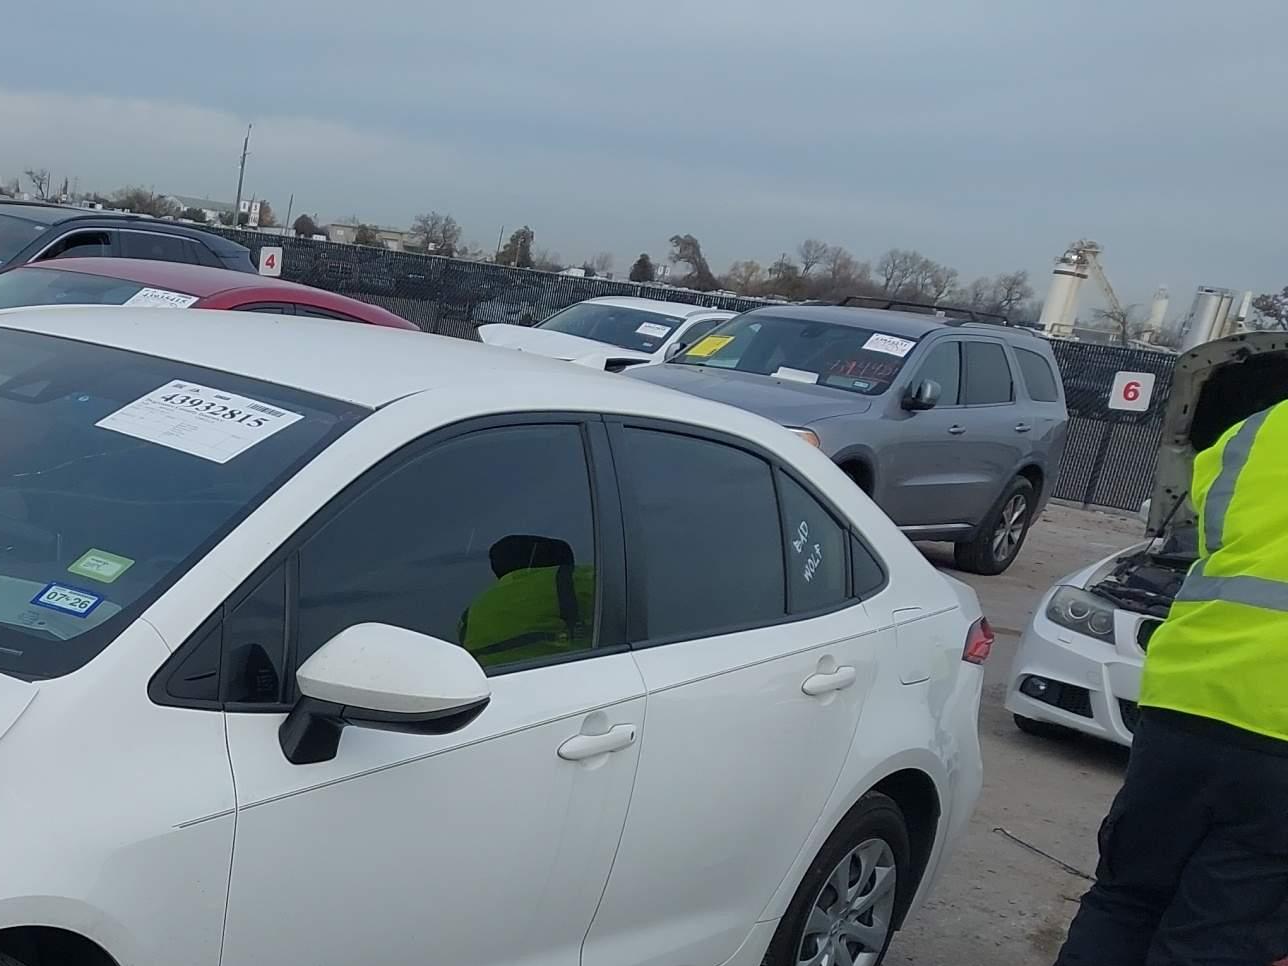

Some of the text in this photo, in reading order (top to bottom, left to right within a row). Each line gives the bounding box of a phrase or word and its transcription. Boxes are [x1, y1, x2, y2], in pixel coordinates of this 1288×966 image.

[265, 253, 276, 269] 4
[1123, 381, 1141, 401] 6
[161, 392, 270, 428] 43932815
[46, 591, 91, 609] 07-26
